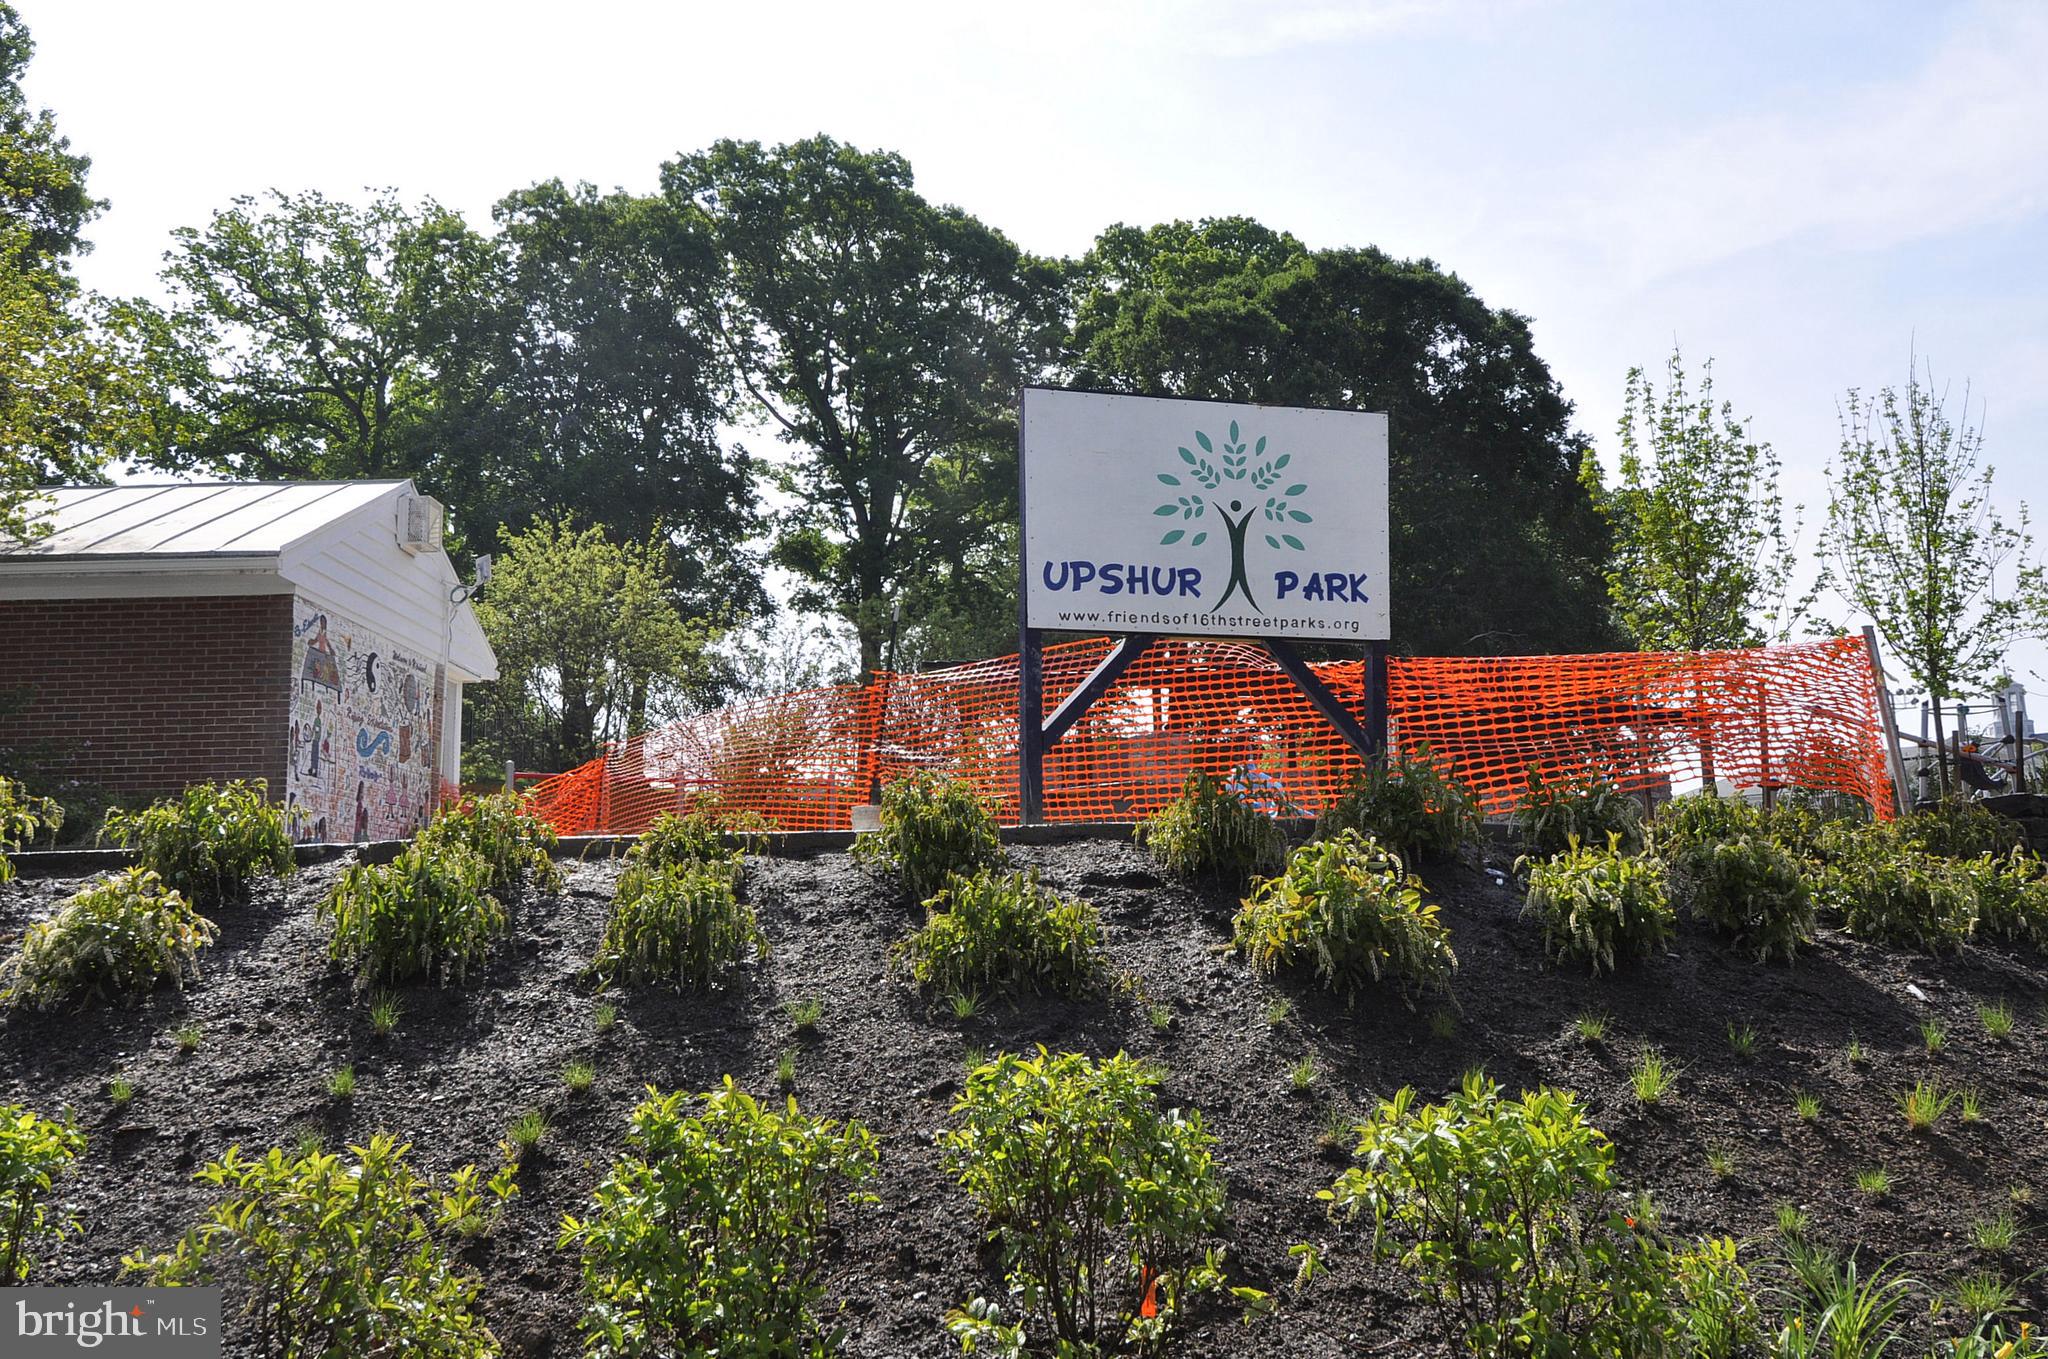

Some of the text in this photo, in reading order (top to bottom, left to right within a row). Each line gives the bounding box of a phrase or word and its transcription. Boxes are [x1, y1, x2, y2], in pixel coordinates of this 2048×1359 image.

[1042, 560, 1369, 603] UPSHUR PARK
[1058, 610, 1360, 633] www.friendsof16thstreetparks.org
